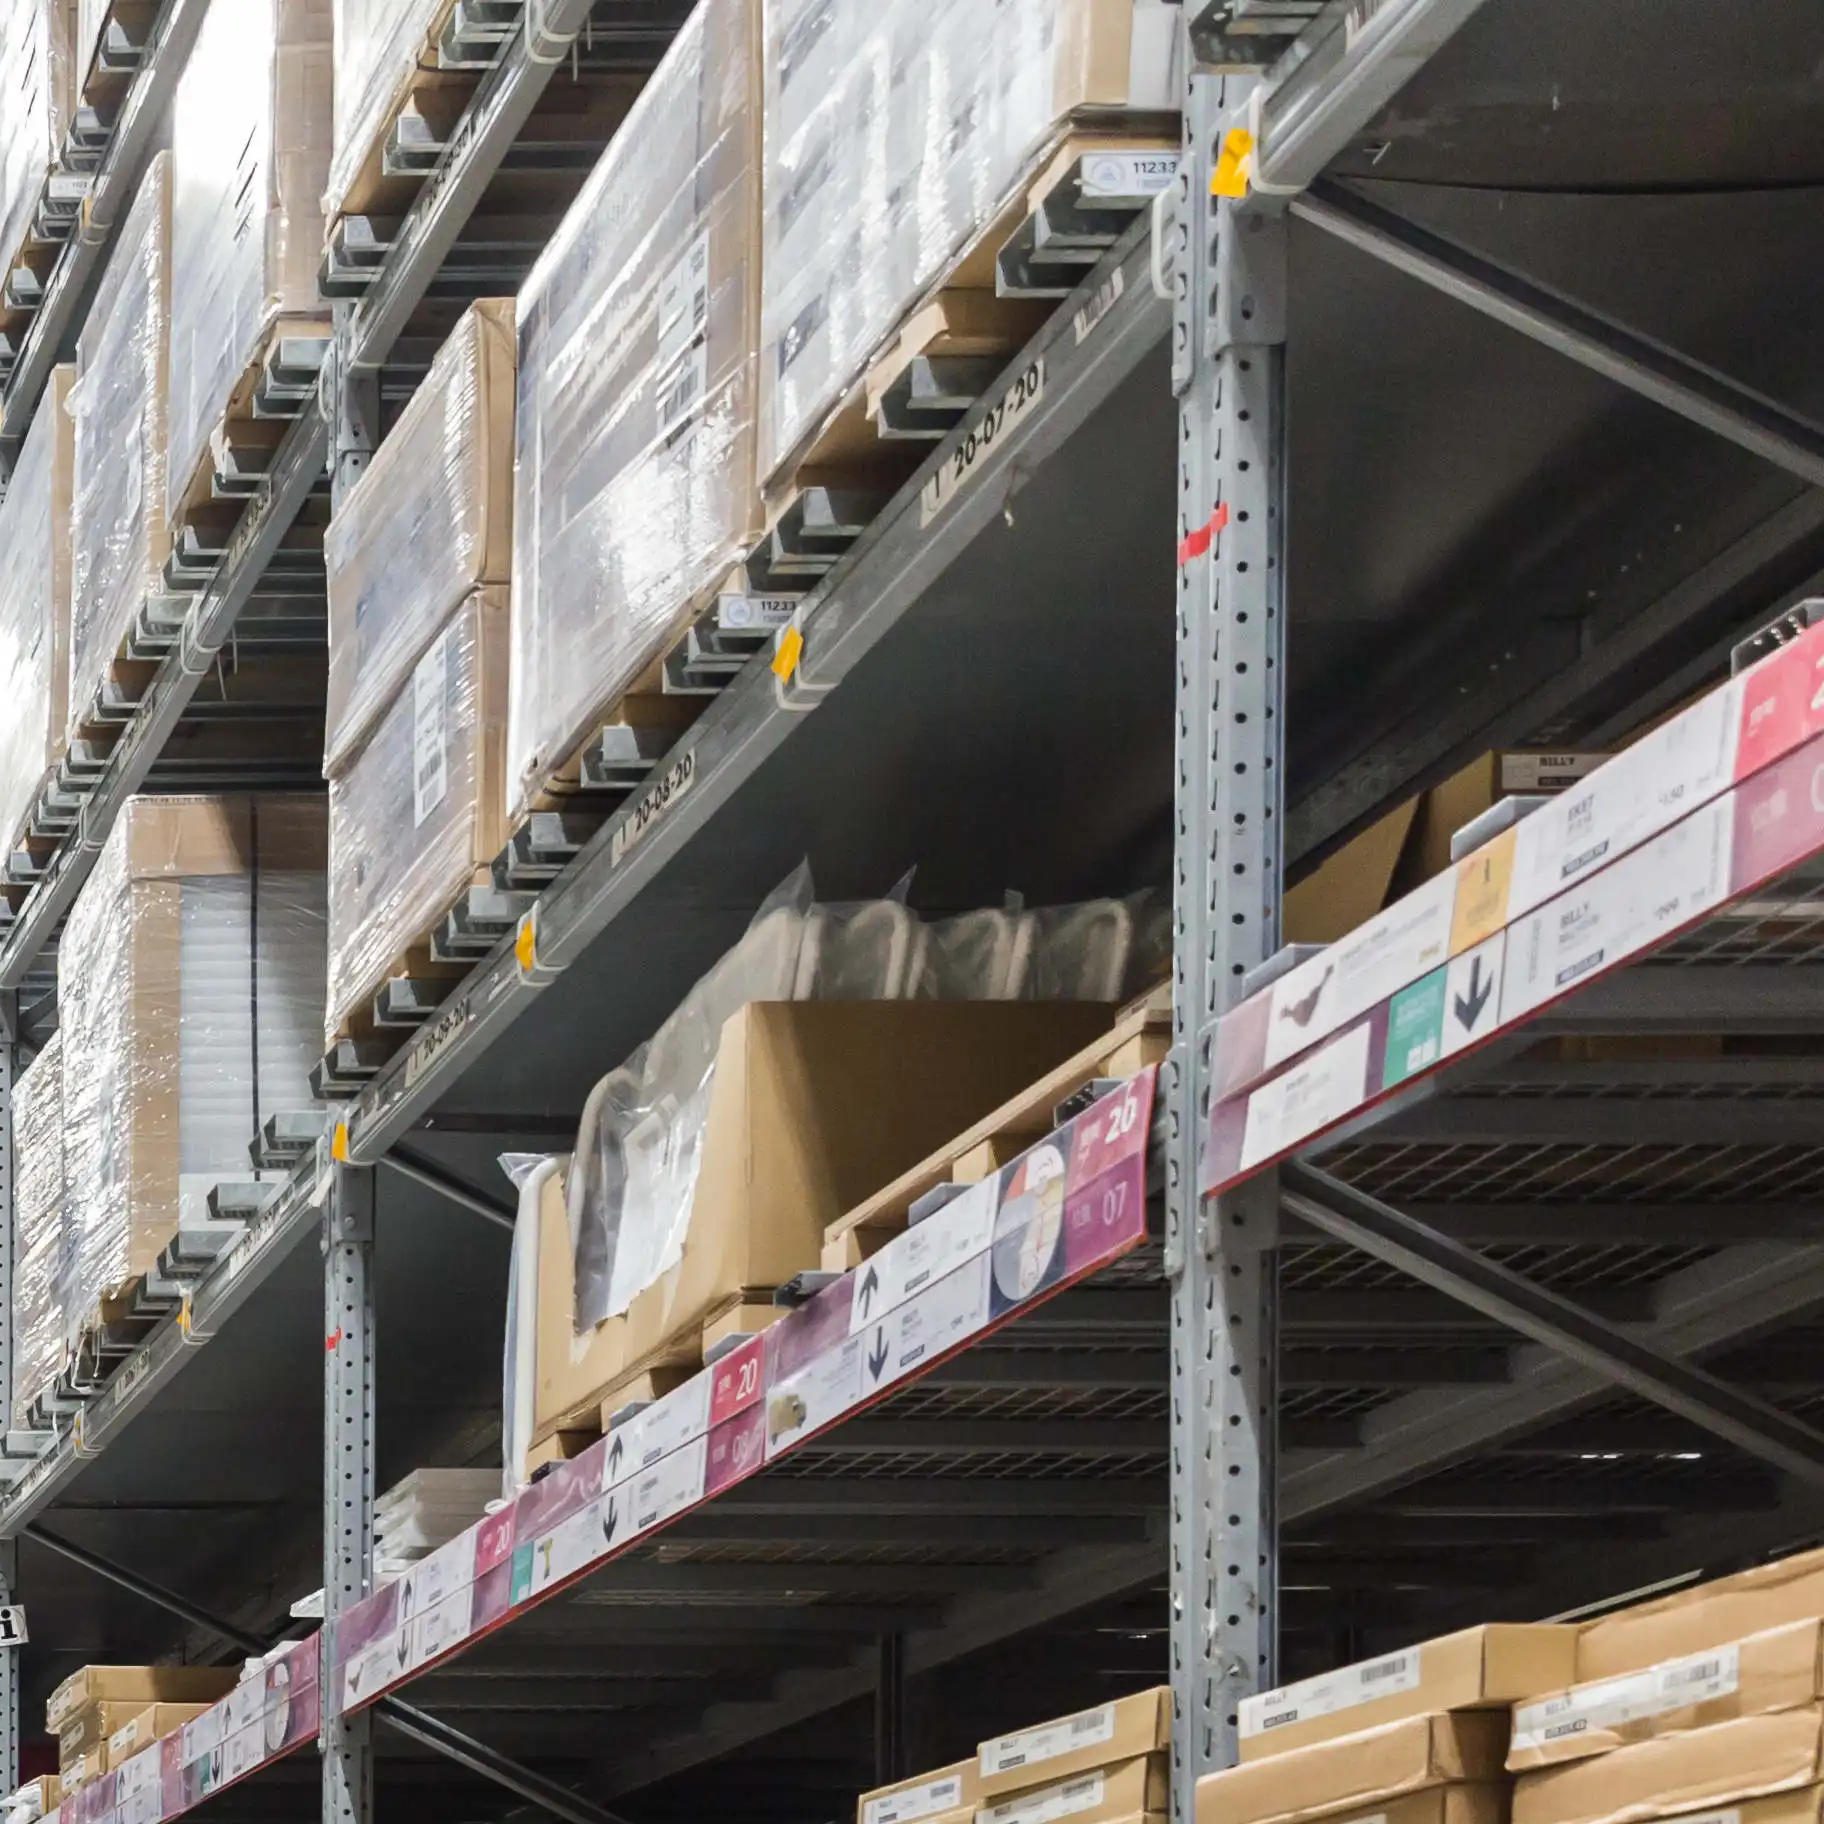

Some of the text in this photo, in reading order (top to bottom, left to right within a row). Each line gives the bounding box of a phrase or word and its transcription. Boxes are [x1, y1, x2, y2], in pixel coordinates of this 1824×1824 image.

[953, 362, 1040, 481] 20-07-20
[1539, 757, 1575, 767] BILLY
[635, 752, 694, 832] 20-08-20
[1560, 901, 1591, 930] BILLY
[1103, 1180, 1129, 1226] 07
[735, 1358, 758, 1401] 20
[494, 1521, 511, 1557] 20
[0, 1609, 18, 1640] i
